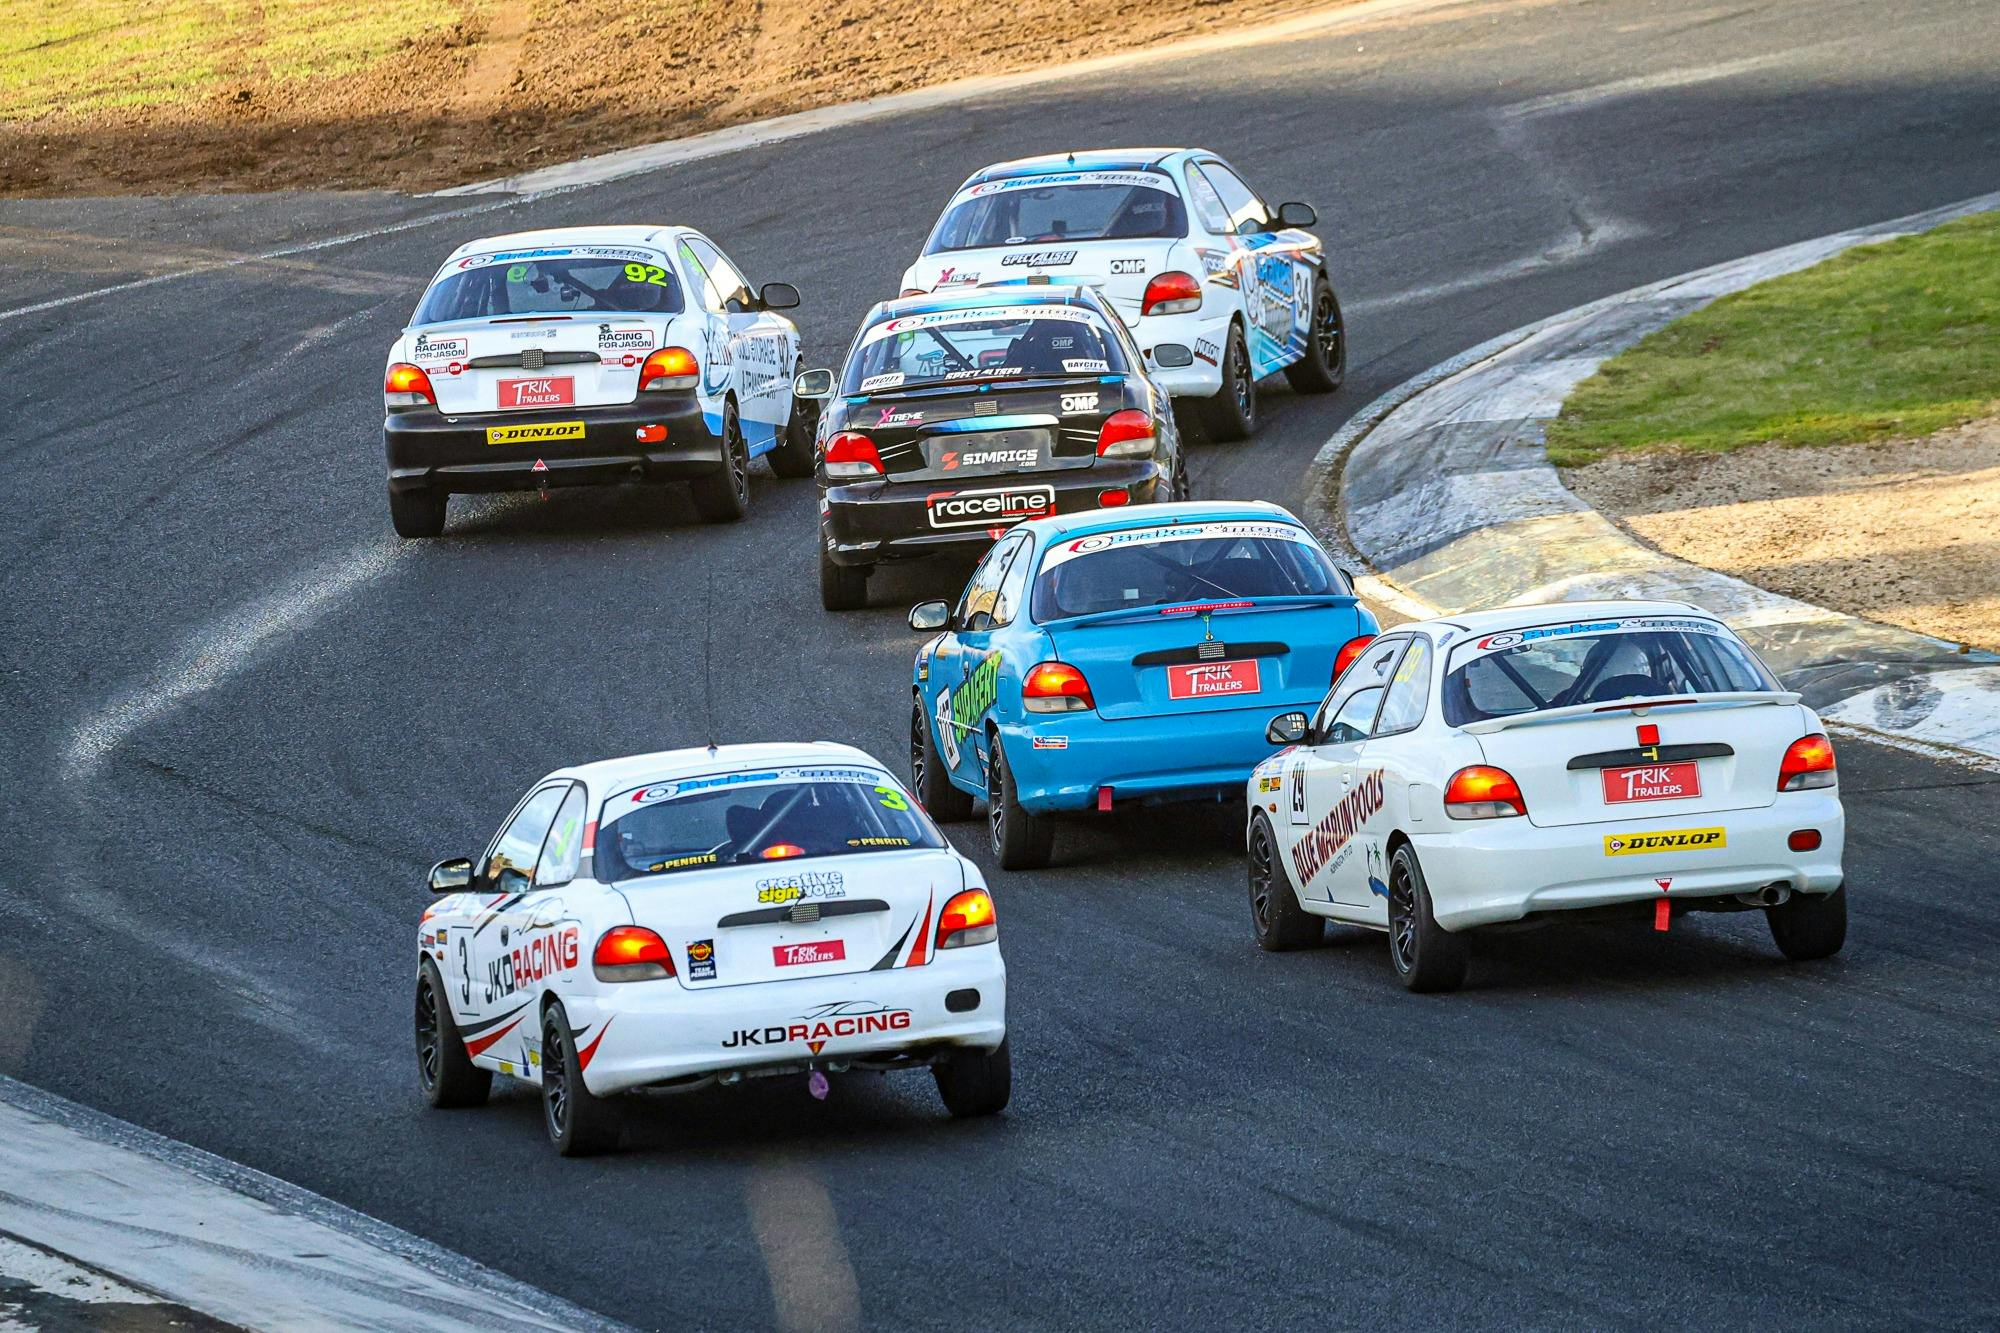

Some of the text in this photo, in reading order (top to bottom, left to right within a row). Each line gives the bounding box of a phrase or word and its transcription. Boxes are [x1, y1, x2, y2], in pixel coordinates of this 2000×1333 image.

[624, 263, 669, 287] 92
[1111, 261, 1144, 273] OMP
[599, 333, 642, 341] RACING
[618, 340, 652, 348] JASON
[1051, 338, 1073, 347] OMP
[414, 349, 465, 360] FOR JASON
[415, 342, 456, 353] RACING
[777, 334, 791, 379] 92
[512, 380, 553, 405] TRIK
[522, 394, 560, 403] TRAILERS
[1062, 396, 1099, 411] OMP
[873, 407, 926, 431] XTREME
[506, 426, 580, 439] DUNLOP
[962, 449, 1038, 466] SIMRIGS
[936, 491, 1047, 517] raceline
[1185, 664, 1232, 695] TRIK
[1197, 681, 1243, 692] TRAILERS
[1292, 761, 1305, 812] 29
[1620, 767, 1671, 799] TRIK
[1634, 784, 1682, 797] TRAILERS
[874, 786, 909, 811] 3
[1291, 766, 1385, 888] BLUE MARLIN POOLS
[860, 838, 910, 846] PENRITE
[1628, 832, 1720, 850] DUNLOP
[665, 854, 717, 869] PENRITE
[756, 871, 843, 891] creative
[784, 945, 819, 964] TRIK
[793, 952, 834, 964] TRAILERS
[459, 936, 470, 1006] 3
